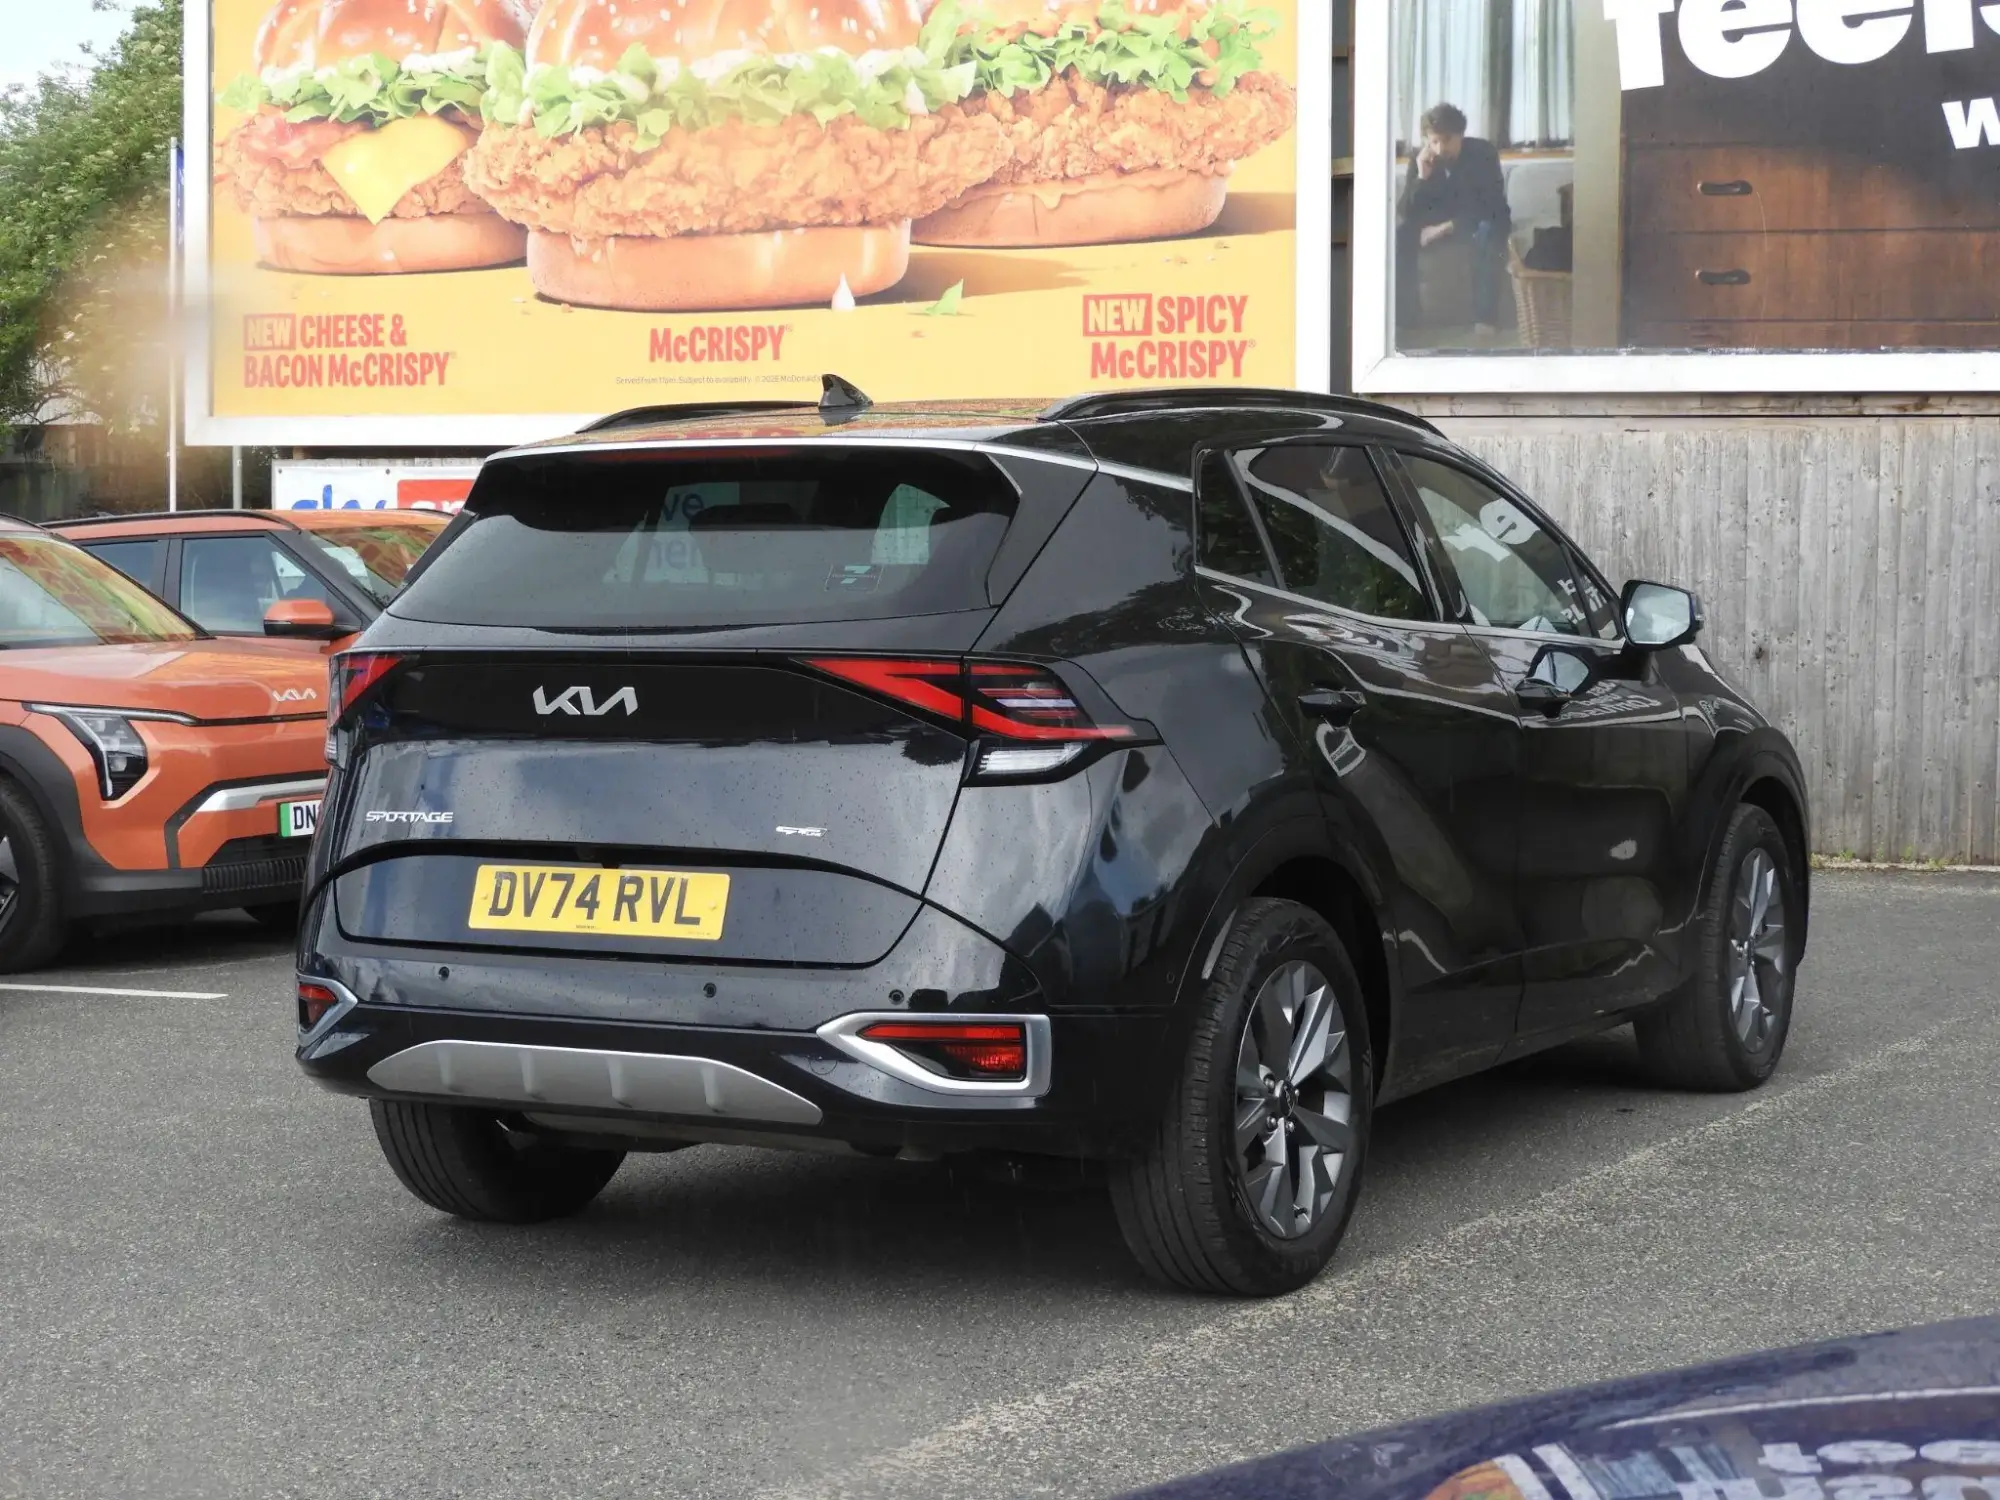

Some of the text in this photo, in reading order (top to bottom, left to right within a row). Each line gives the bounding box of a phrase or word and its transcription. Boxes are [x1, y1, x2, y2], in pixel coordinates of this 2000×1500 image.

[246, 313, 407, 348] NEW CHEESE &
[1088, 294, 1249, 334] NEW SPICY
[649, 325, 785, 363] McCRISPY
[1091, 340, 1248, 379] McCRISPY
[244, 352, 450, 388] BACON McCRISPY
[533, 686, 638, 716] KIA
[366, 810, 454, 824] SPORTAGE
[488, 871, 702, 926] DV74 RVL
